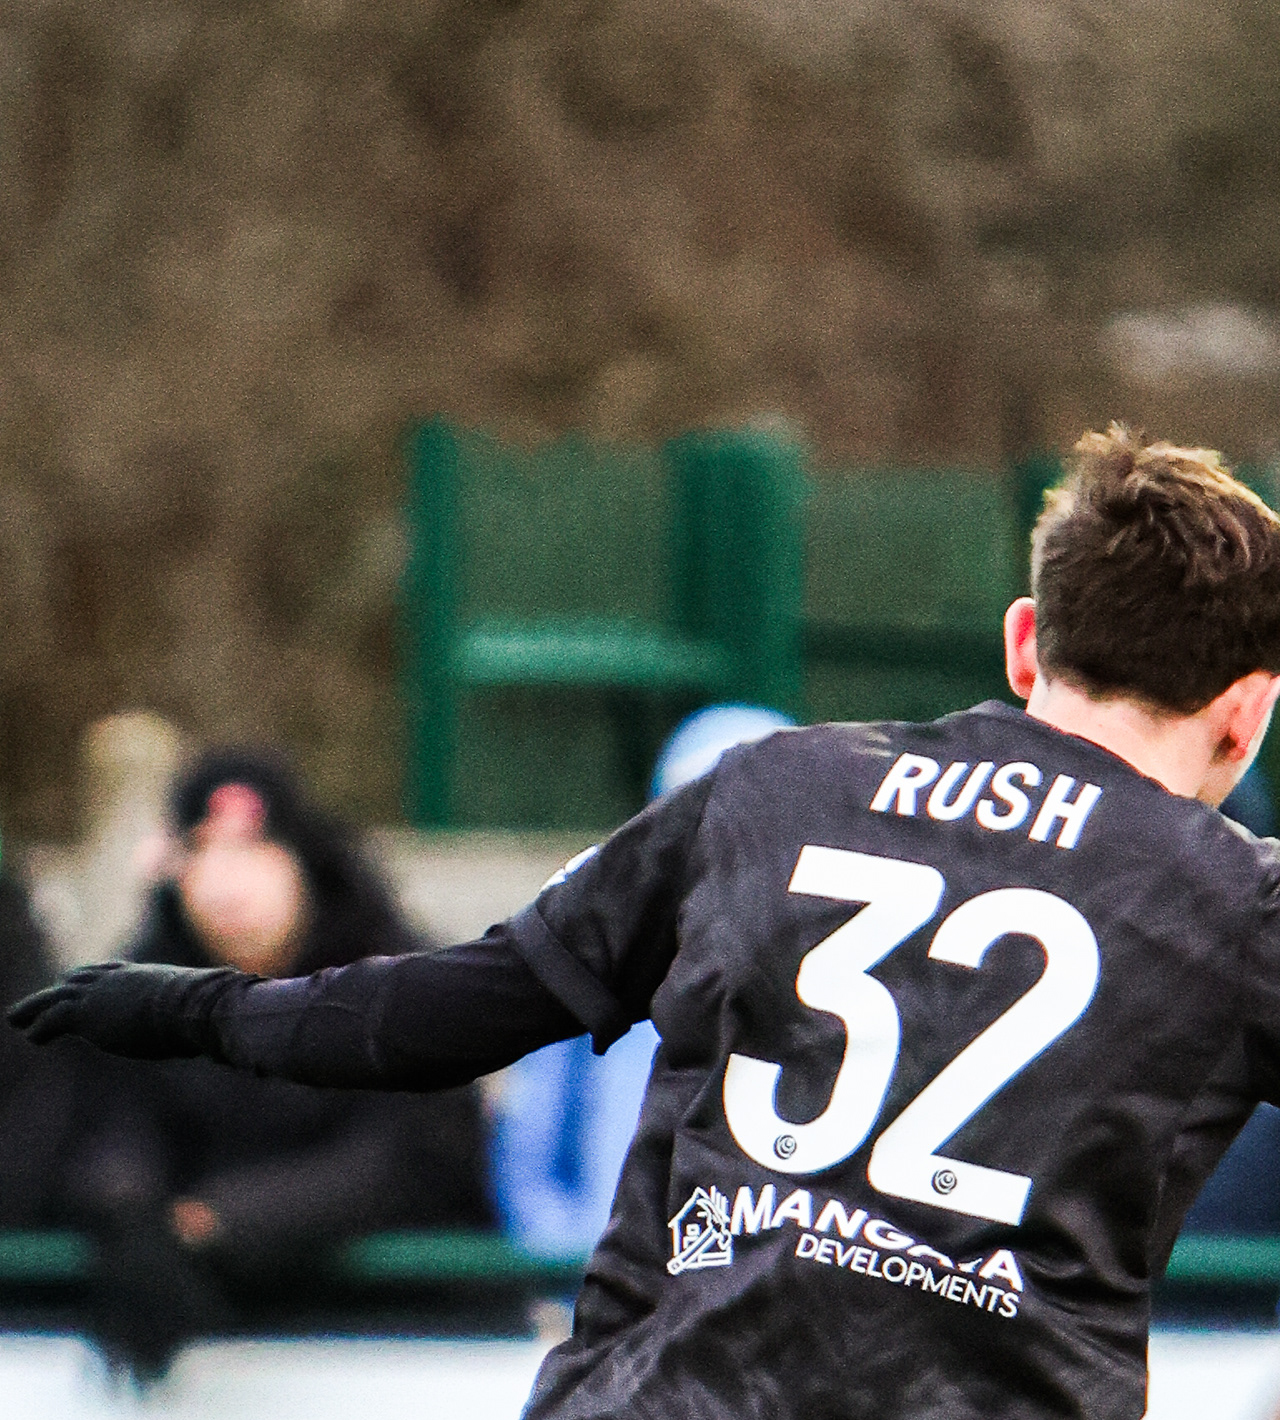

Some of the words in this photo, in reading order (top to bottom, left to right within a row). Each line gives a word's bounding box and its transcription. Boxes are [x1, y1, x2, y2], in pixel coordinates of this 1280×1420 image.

[870, 751, 1102, 850] RUSH
[722, 843, 1102, 1226] 32
[794, 1231, 1021, 1320] DEVELOPMENTS
